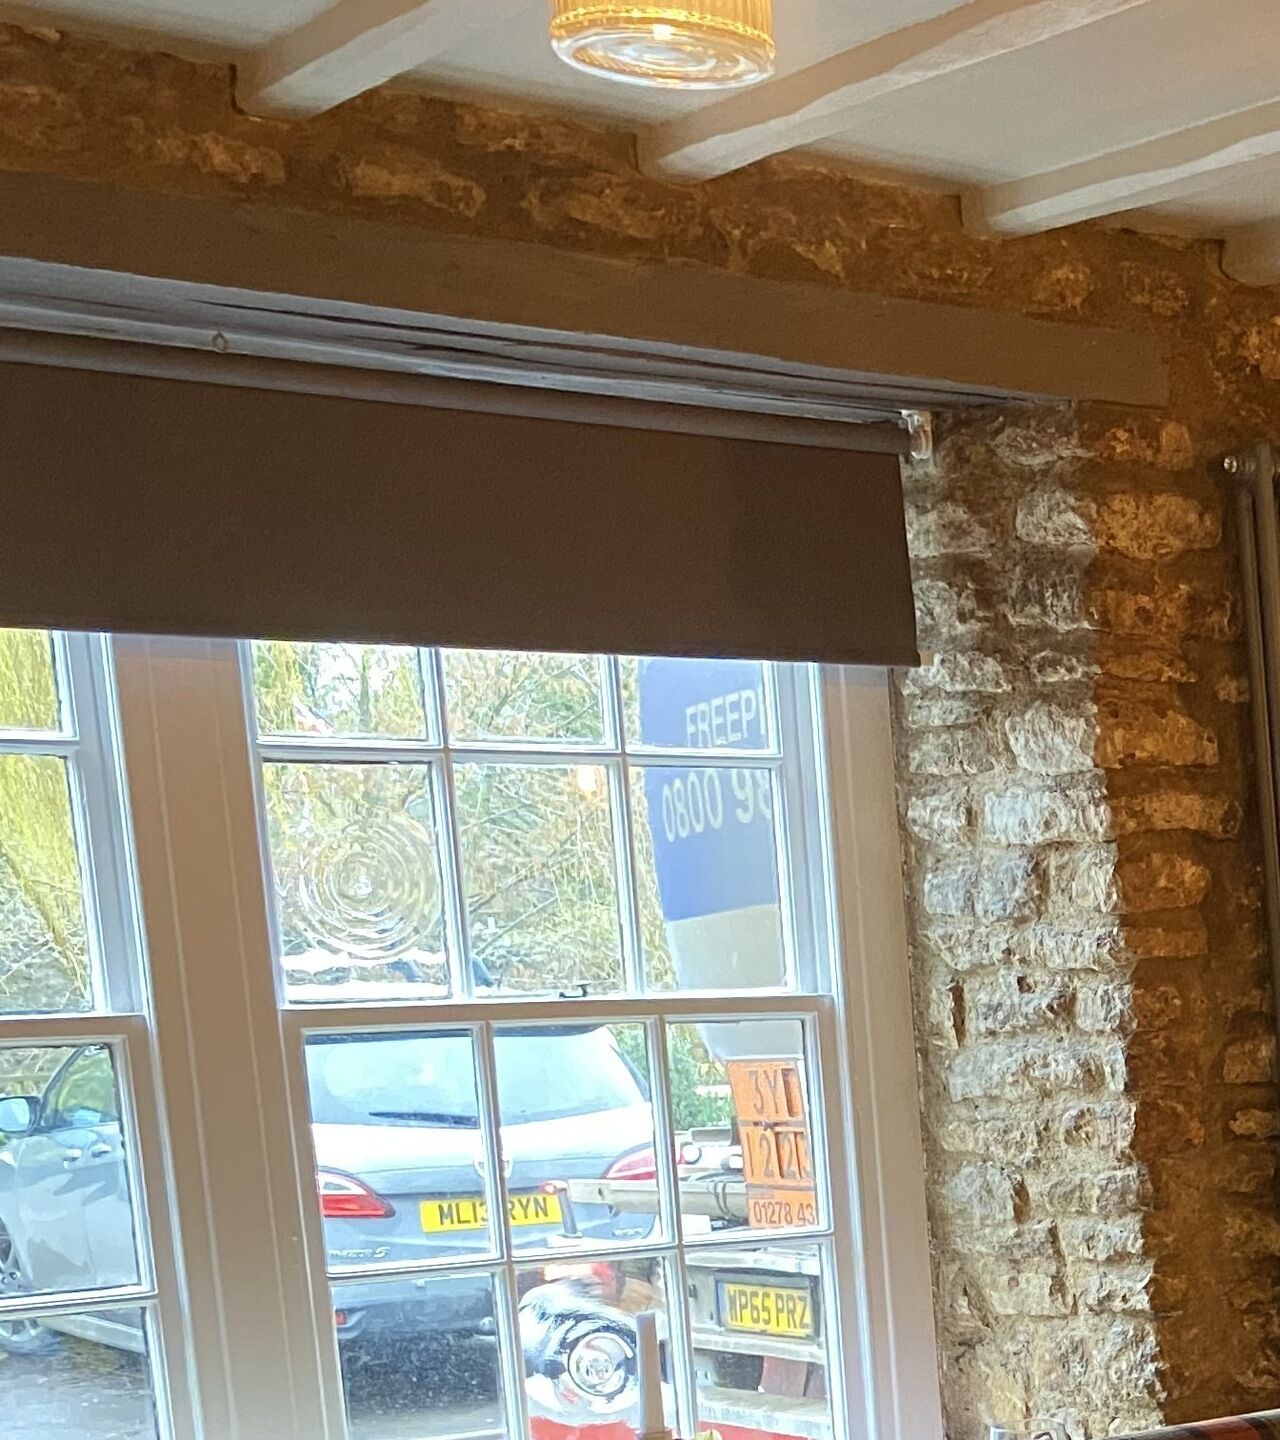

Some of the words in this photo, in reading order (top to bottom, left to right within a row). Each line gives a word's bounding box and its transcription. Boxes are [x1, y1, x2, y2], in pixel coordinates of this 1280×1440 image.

[685, 685, 766, 748] FREEP
[661, 768, 724, 842] 0800
[508, 1196, 549, 1221] RYN
[753, 1201, 793, 1225] 01278
[774, 1292, 811, 1330] PRZ
